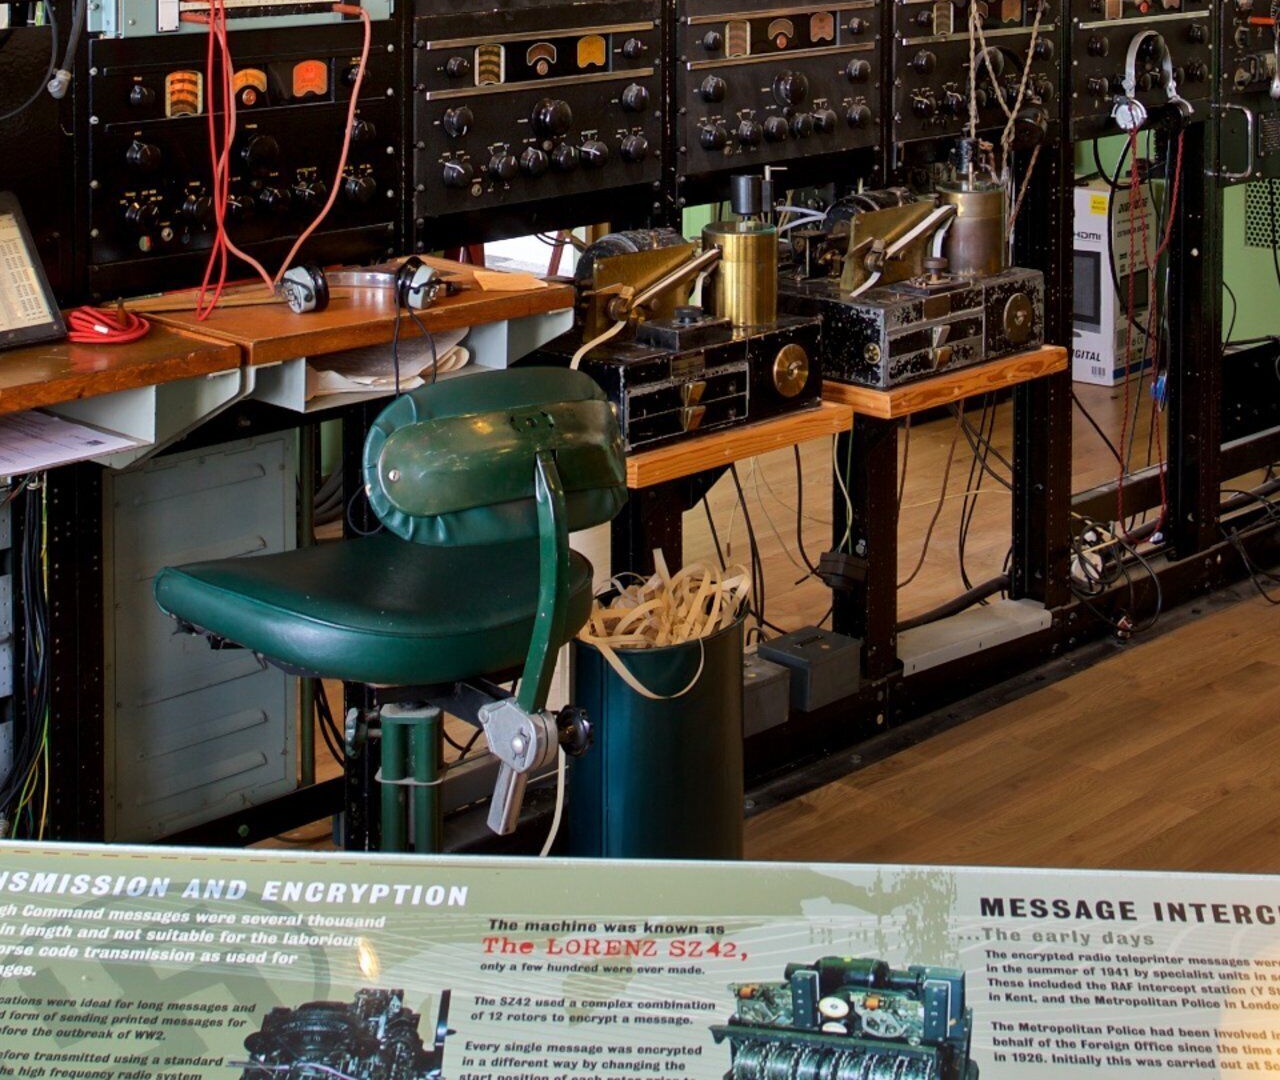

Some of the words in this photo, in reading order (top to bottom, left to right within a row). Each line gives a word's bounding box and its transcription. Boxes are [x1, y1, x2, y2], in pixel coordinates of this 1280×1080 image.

[182, 879, 248, 900] AND
[261, 881, 469, 907] ENCRYPTION
[21, 905, 105, 920] Command
[108, 910, 190, 924] messages
[195, 912, 236, 924] were
[240, 913, 302, 926] several
[307, 914, 385, 928] thousand
[980, 898, 1137, 921] MESSAGE
[21, 923, 72, 940] length
[80, 927, 109, 939] and
[113, 928, 141, 940] not
[146, 928, 215, 943] suitable
[220, 930, 246, 944] for
[250, 931, 278, 944] the
[282, 932, 362, 946] laborious
[489, 920, 518, 931] The
[525, 920, 596, 932] machine
[603, 923, 636, 933] was
[644, 922, 698, 934] known
[705, 925, 725, 935] as
[1032, 930, 1091, 946] early
[1102, 931, 1154, 947] days
[38, 945, 78, 958] code
[84, 947, 195, 962] transmission
[200, 951, 220, 962] as
[225, 950, 267, 963] used
[272, 951, 298, 965] for
[482, 937, 535, 954] The
[547, 939, 657, 957] LORENZ
[669, 940, 748, 961] SZ42,
[985, 950, 1007, 959] The
[1012, 951, 1074, 962] encrypted
[1079, 953, 1111, 962] radio
[1116, 954, 1183, 965] teleprinter
[1188, 956, 1250, 967] messages
[480, 962, 505, 972] only
[522, 963, 543, 971] few
[547, 963, 598, 973] hundred
[603, 965, 632, 973] were
[637, 966, 664, 974] ever
[668, 965, 705, 975] made.
[47, 999, 76, 1008] were
[80, 998, 111, 1009] ideal
[115, 999, 134, 1010] for
[137, 1000, 164, 1011] long
[167, 1002, 228, 1013] messages
[232, 1004, 256, 1013] and
[474, 997, 496, 1006] The
[500, 997, 531, 1007] SZ42
[535, 998, 565, 1008] used
[569, 1000, 576, 1008] a
[581, 999, 632, 1009] complex
[637, 1000, 716, 1010] combination
[471, 1012, 485, 1020] of
[488, 1012, 503, 1021] 12
[507, 1013, 547, 1022] rotors
[552, 1014, 564, 1022] to
[569, 1014, 617, 1026] encrypt
[634, 1016, 693, 1026] message.
